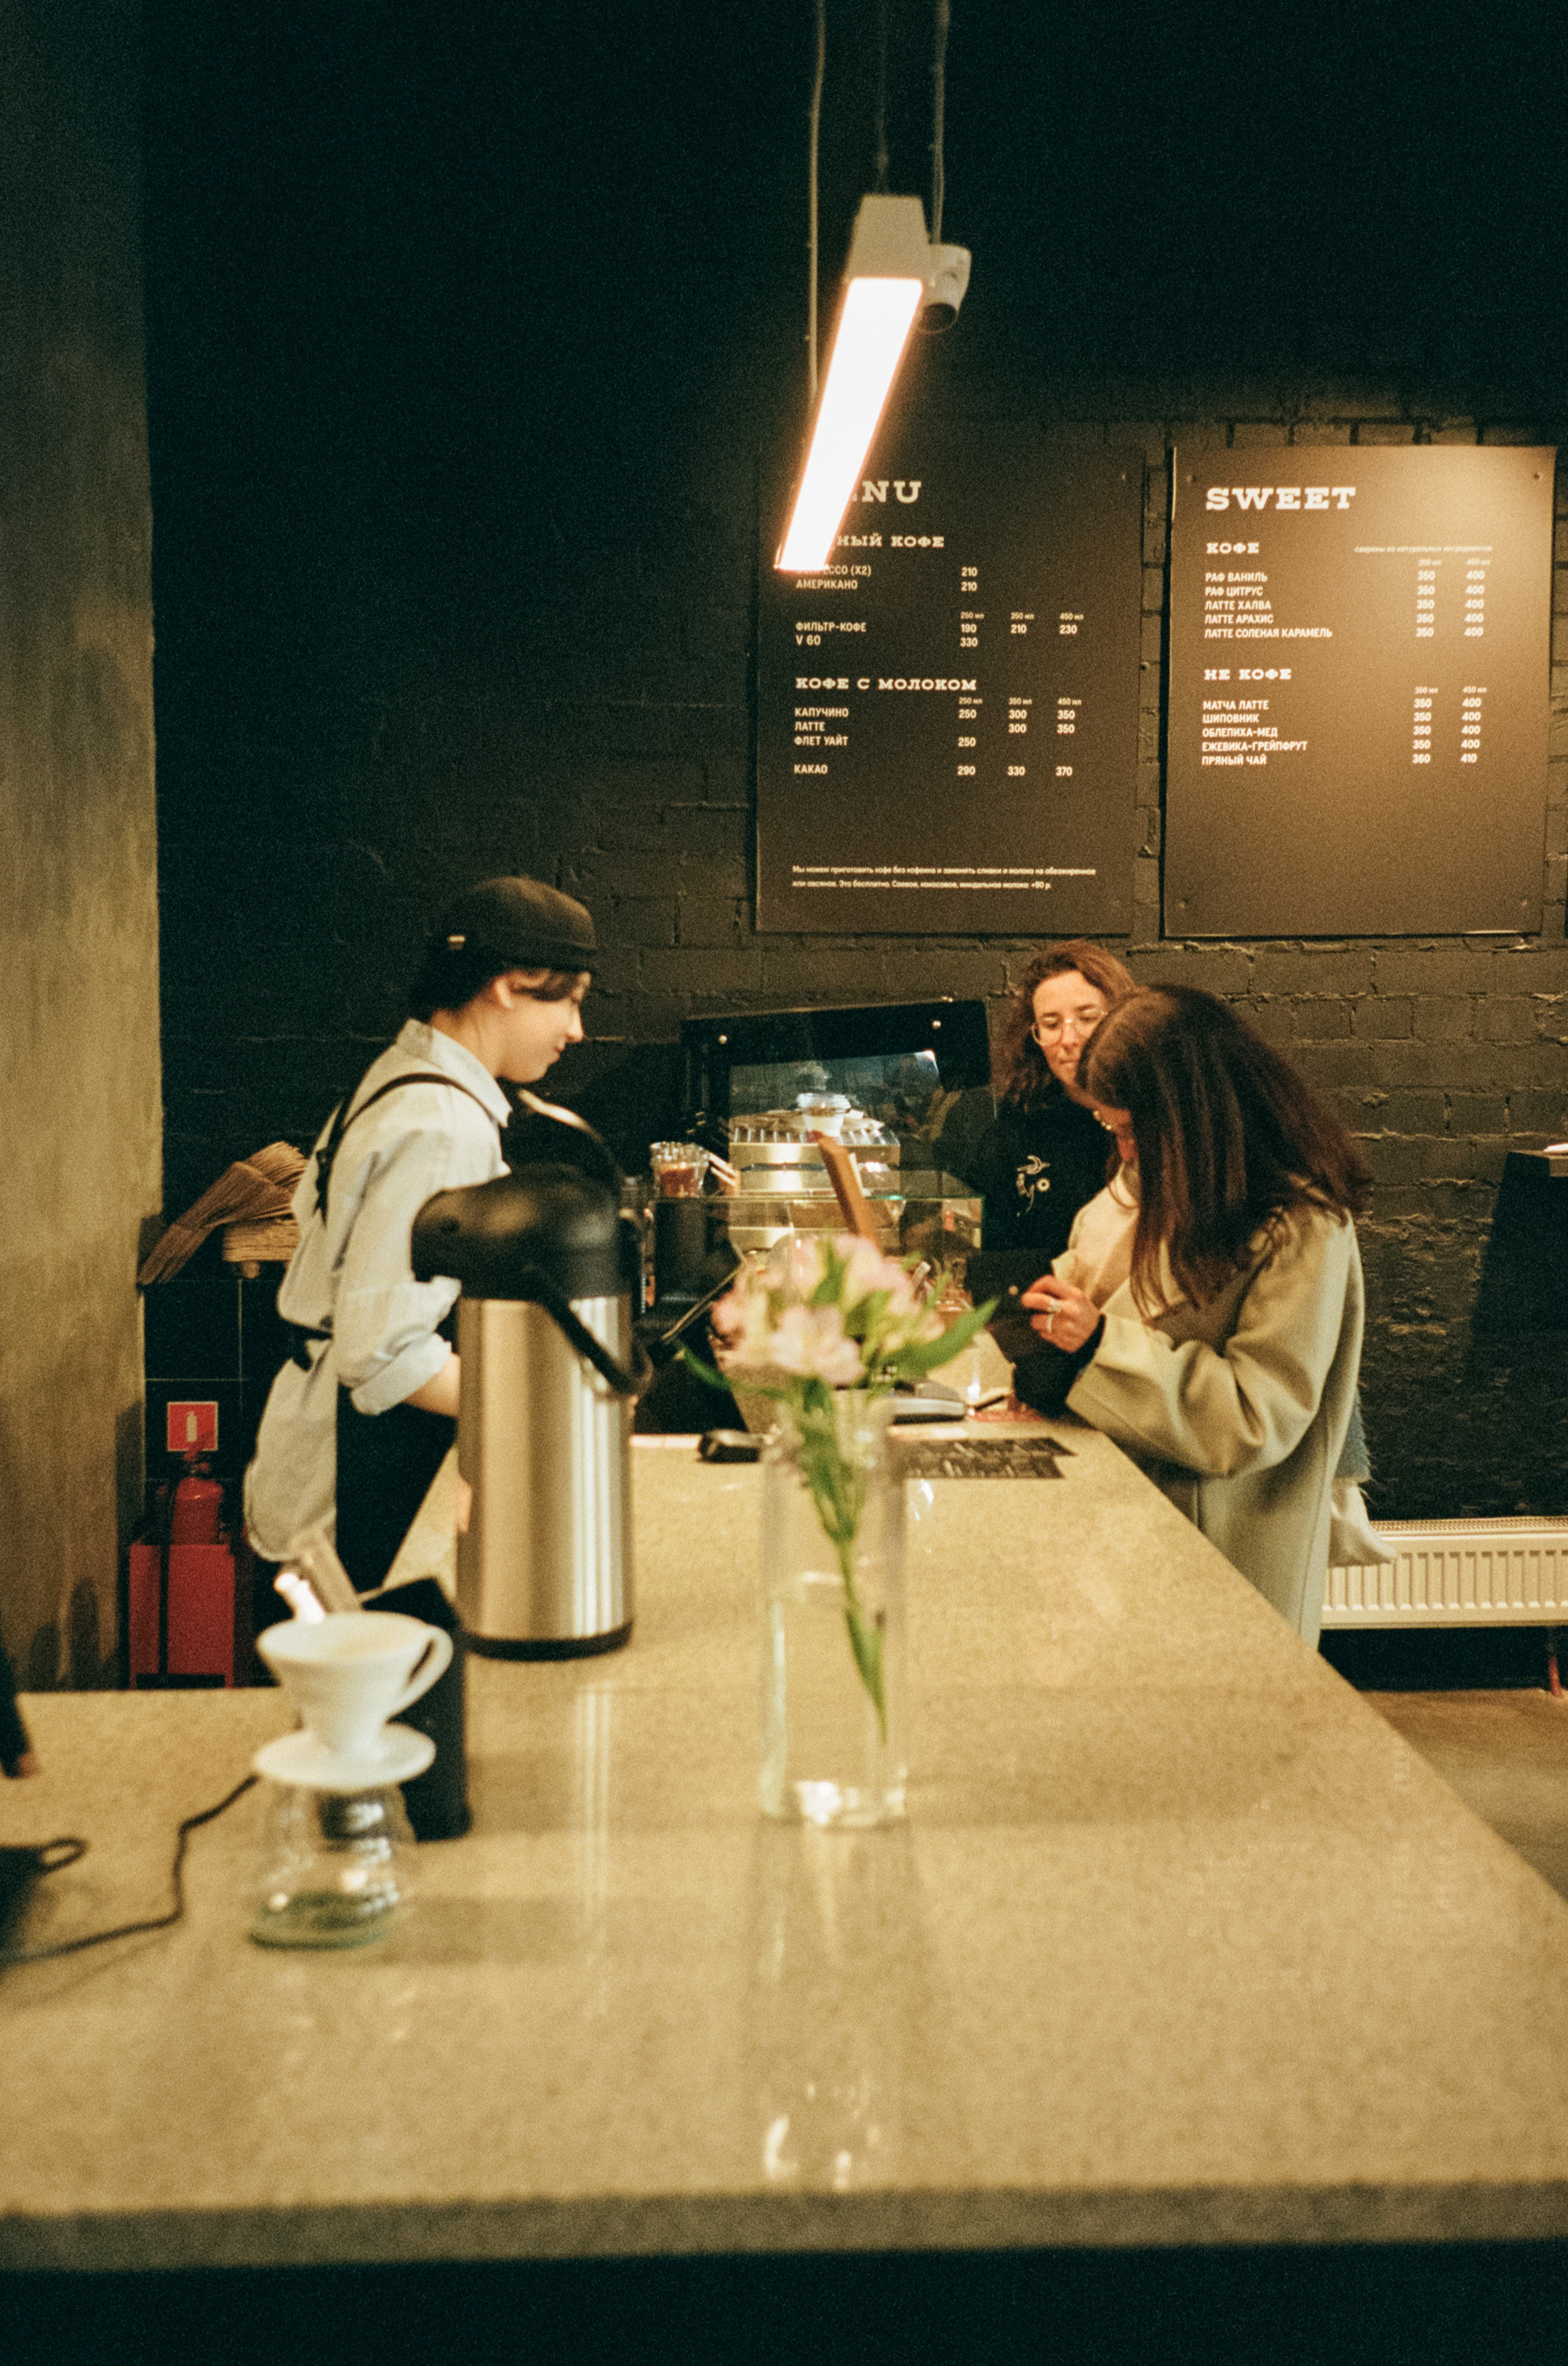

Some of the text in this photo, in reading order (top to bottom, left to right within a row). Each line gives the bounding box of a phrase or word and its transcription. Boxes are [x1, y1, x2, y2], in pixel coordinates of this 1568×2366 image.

[853, 481, 921, 503] NU
[1206, 488, 1356, 510] SWEET
[837, 533, 945, 548] НЫЙ КОФЕ
[1206, 542, 1260, 554] КОФЕ
[961, 567, 978, 577] 210
[1206, 572, 1267, 582] РАФ ВАНИЛЬ
[1418, 571, 1436, 581] 350
[1466, 571, 1485, 580] 400
[796, 578, 858, 590] АМЕРИКАНО
[961, 582, 977, 591] 210
[1206, 586, 1263, 597] РАФ ЦИТРУС
[1418, 585, 1435, 595] 350
[1466, 585, 1484, 595] 400
[1205, 601, 1271, 611] ЛАТТЕ ХАЛВА
[1418, 600, 1435, 609] 350
[1466, 599, 1484, 609] 400
[1204, 615, 1273, 624] ЛАТТЕ АРАХИС
[1416, 613, 1434, 623] 350
[1465, 613, 1484, 623] 400
[796, 622, 867, 632] ФИЛЬТР-КОФЕ
[960, 623, 977, 634] 190
[1010, 623, 1027, 634] 210
[1060, 624, 1077, 634] 230
[1416, 627, 1434, 638] 350
[1464, 627, 1484, 637] 400
[1204, 628, 1332, 638] ЛАТТЕ СОЛЕНАЯ КАРАМЕЛЬ
[796, 634, 821, 645] V 60
[960, 637, 978, 647] 330
[1204, 668, 1291, 680] НЕ КОФЕ
[796, 678, 977, 690] КОФЕ С МОЛОКОМ
[1203, 700, 1269, 710] МАТЧА ЛАТТЕ
[1414, 698, 1432, 709] 350
[1462, 698, 1481, 708] 400
[794, 707, 849, 718] КАПУЧИНО
[959, 709, 976, 720] 250
[1009, 709, 1027, 720] 300
[1057, 709, 1076, 720] 350
[1202, 713, 1259, 723] ШИПОВНИК
[1414, 712, 1432, 722] 350
[1462, 712, 1481, 722] 400
[794, 721, 825, 732] ЛАТТЕ
[1009, 724, 1027, 734] 300
[1057, 724, 1075, 735] 350
[1414, 726, 1431, 735] 350
[1462, 725, 1481, 735] 400
[1202, 727, 1278, 738] ОБЛЕПИХА-МЕД
[794, 734, 849, 746] ФЛЕТ УАЙТ
[958, 737, 976, 748] 250
[1202, 739, 1307, 752] ЕЖЕВИКА-ГРЕЙПФРУТ
[1413, 739, 1431, 750] 350
[1461, 739, 1481, 750] 400
[1202, 753, 1267, 765] ПРЯНЫЙ ЧАЙ
[1412, 753, 1431, 764] 360
[1461, 753, 1477, 764] 410
[794, 764, 828, 775] КАКАО
[957, 765, 975, 776] 290
[1007, 766, 1025, 776] 330
[1056, 766, 1073, 777] 370
